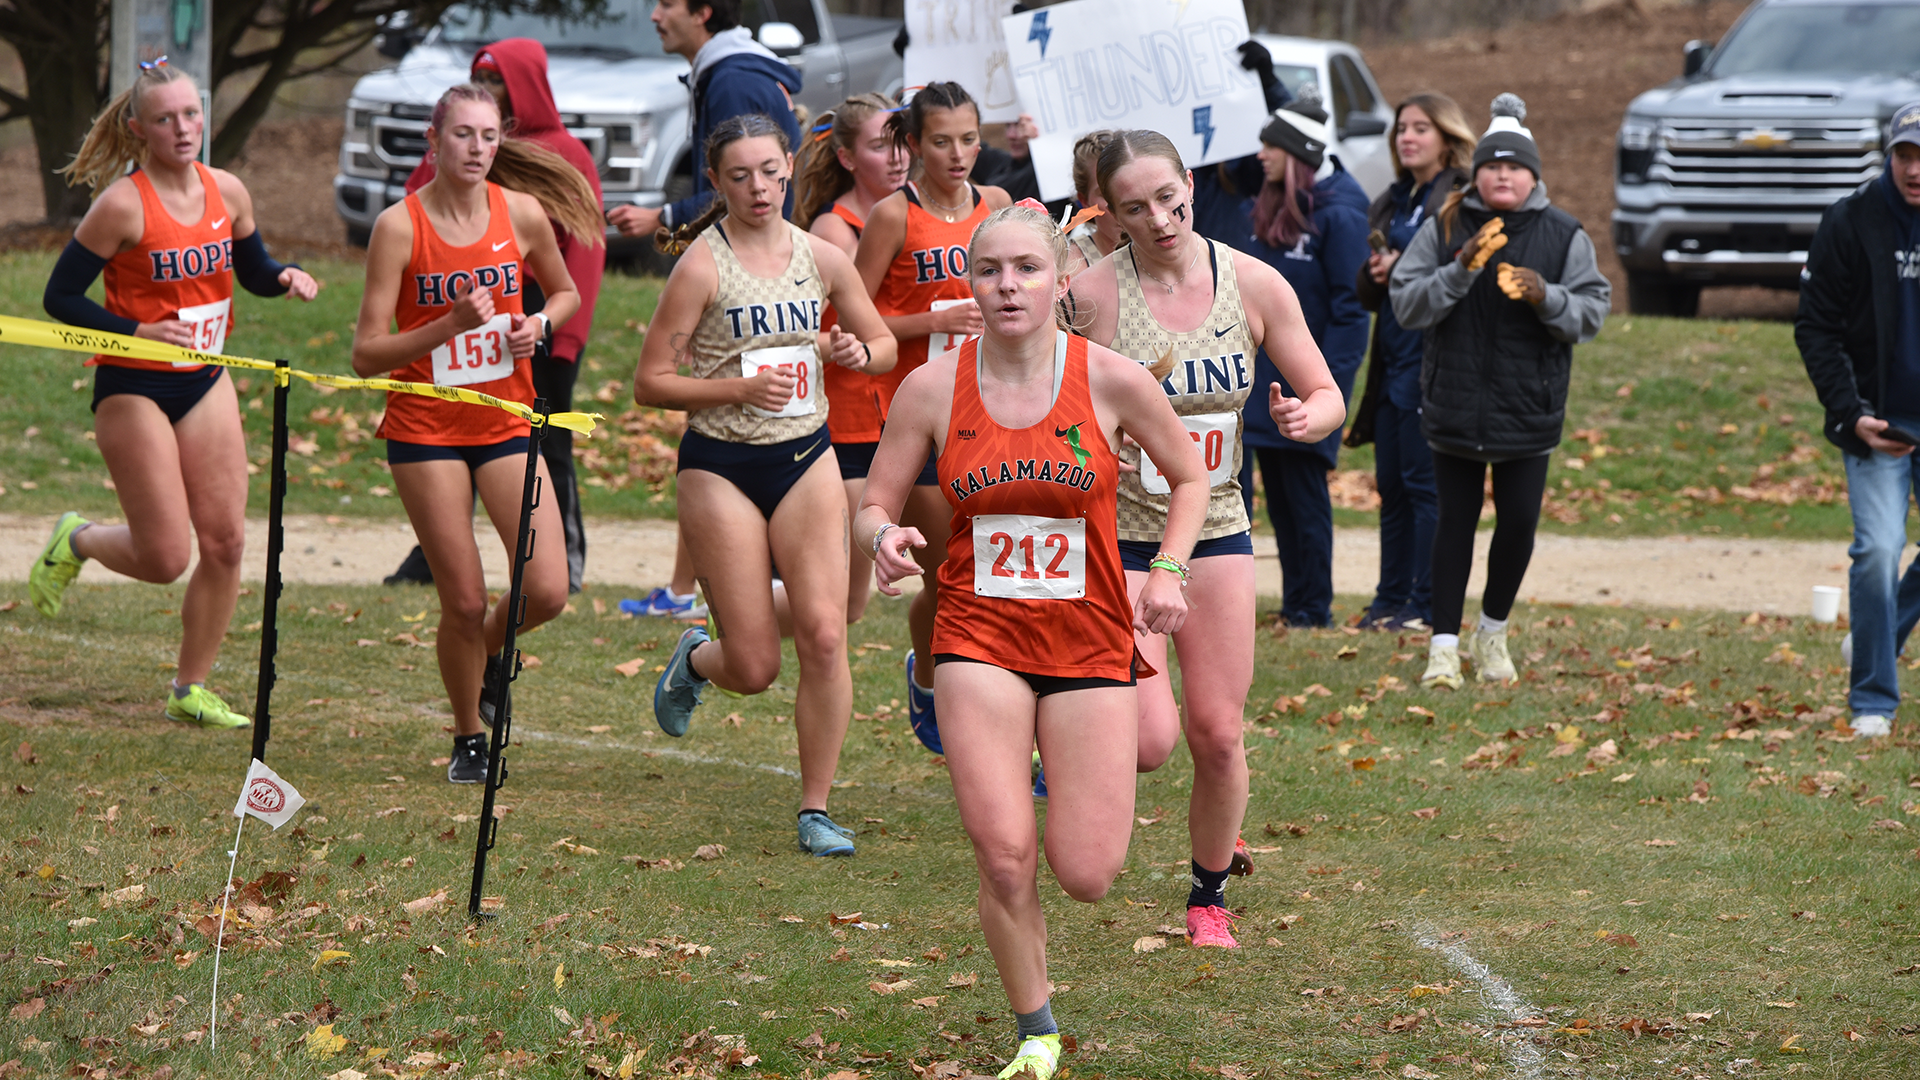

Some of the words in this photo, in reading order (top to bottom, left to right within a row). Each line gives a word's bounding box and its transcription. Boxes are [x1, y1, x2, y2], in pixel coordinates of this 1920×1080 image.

[917, 0, 1007, 47] TRIN
[1015, 16, 1258, 134] THUNDER
[1172, 202, 1186, 223] T
[415, 261, 519, 306] HOPE
[912, 244, 970, 284] HO
[188, 313, 225, 351] 157
[724, 298, 820, 339] TRINE
[445, 330, 503, 371] 153
[1133, 352, 1251, 397] INE
[957, 429, 977, 437] MIAA
[950, 459, 1096, 501] KALAMAZOO
[989, 531, 1070, 580] 212
